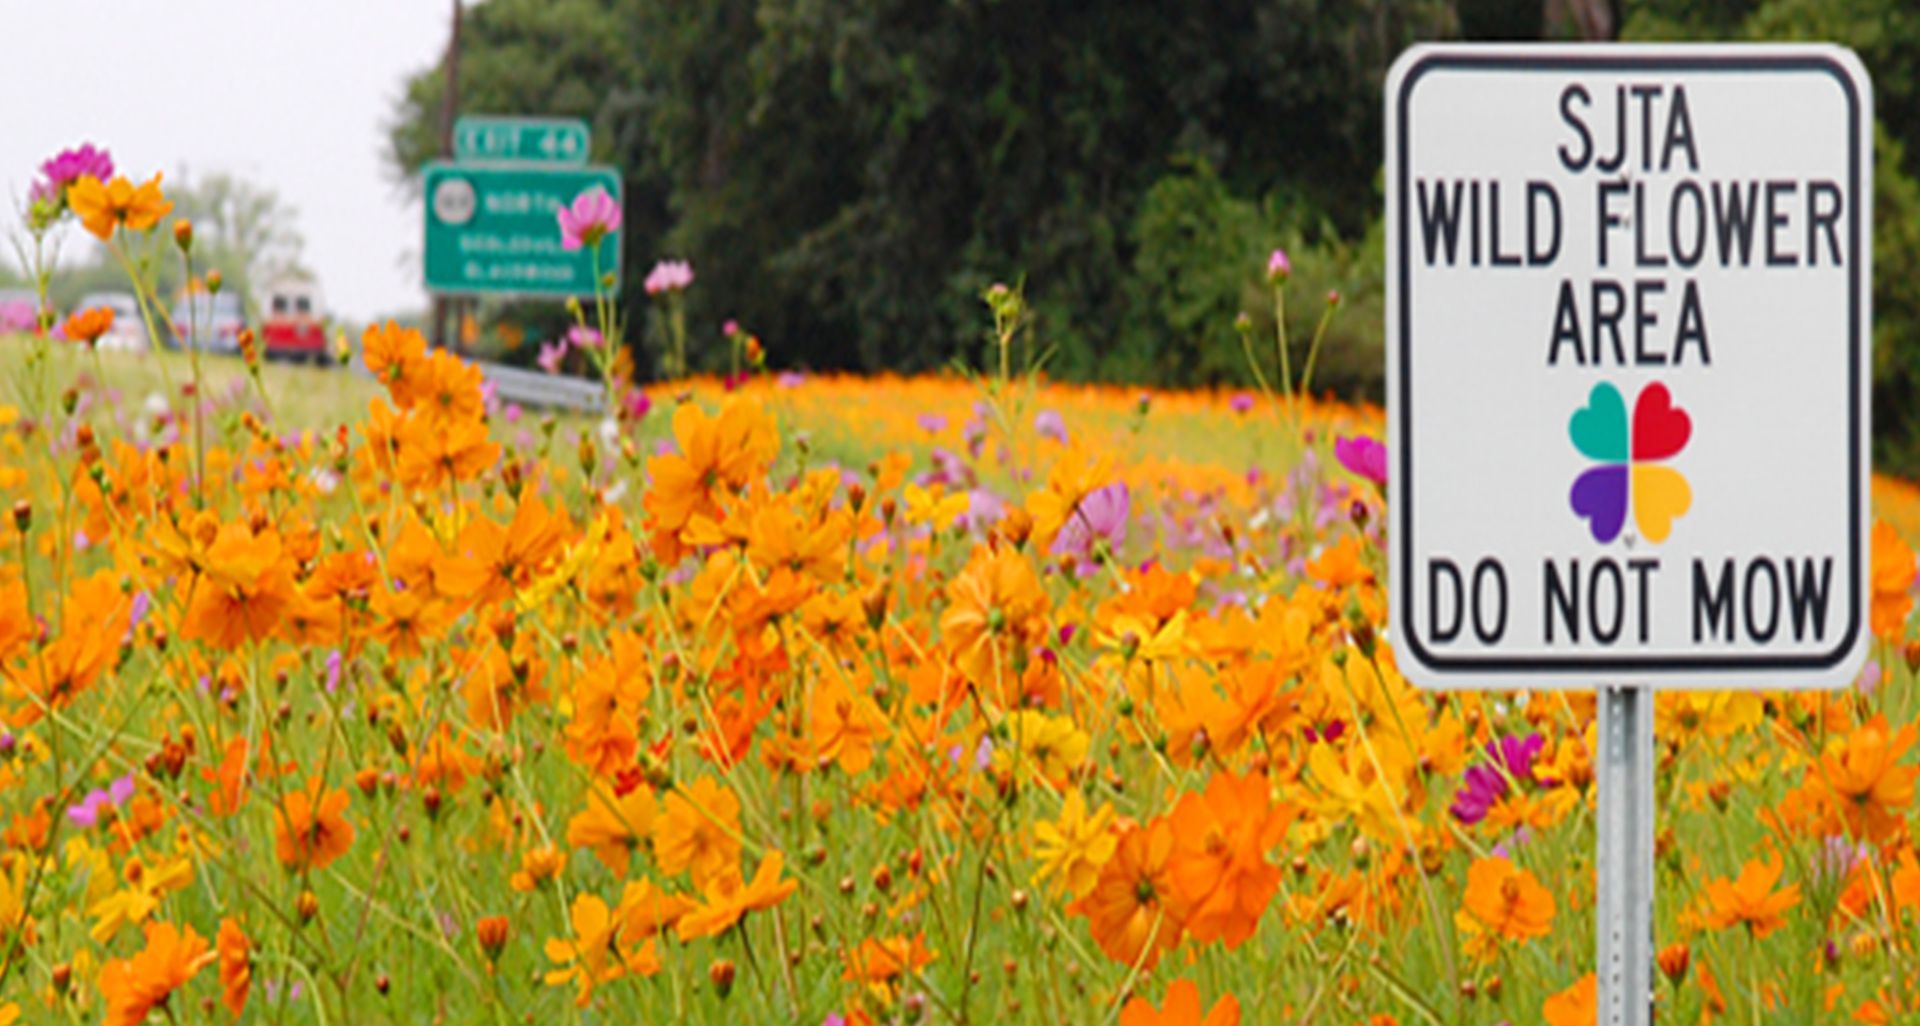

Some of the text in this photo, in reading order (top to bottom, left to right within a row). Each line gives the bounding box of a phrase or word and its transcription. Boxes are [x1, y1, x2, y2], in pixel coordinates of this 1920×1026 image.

[463, 128, 522, 156] EXIT
[1558, 84, 1698, 172] SJTA
[1416, 180, 1842, 268] WILD FLOWER
[1548, 279, 1711, 366] AREA
[1427, 557, 1833, 645] DO NOT MOW
